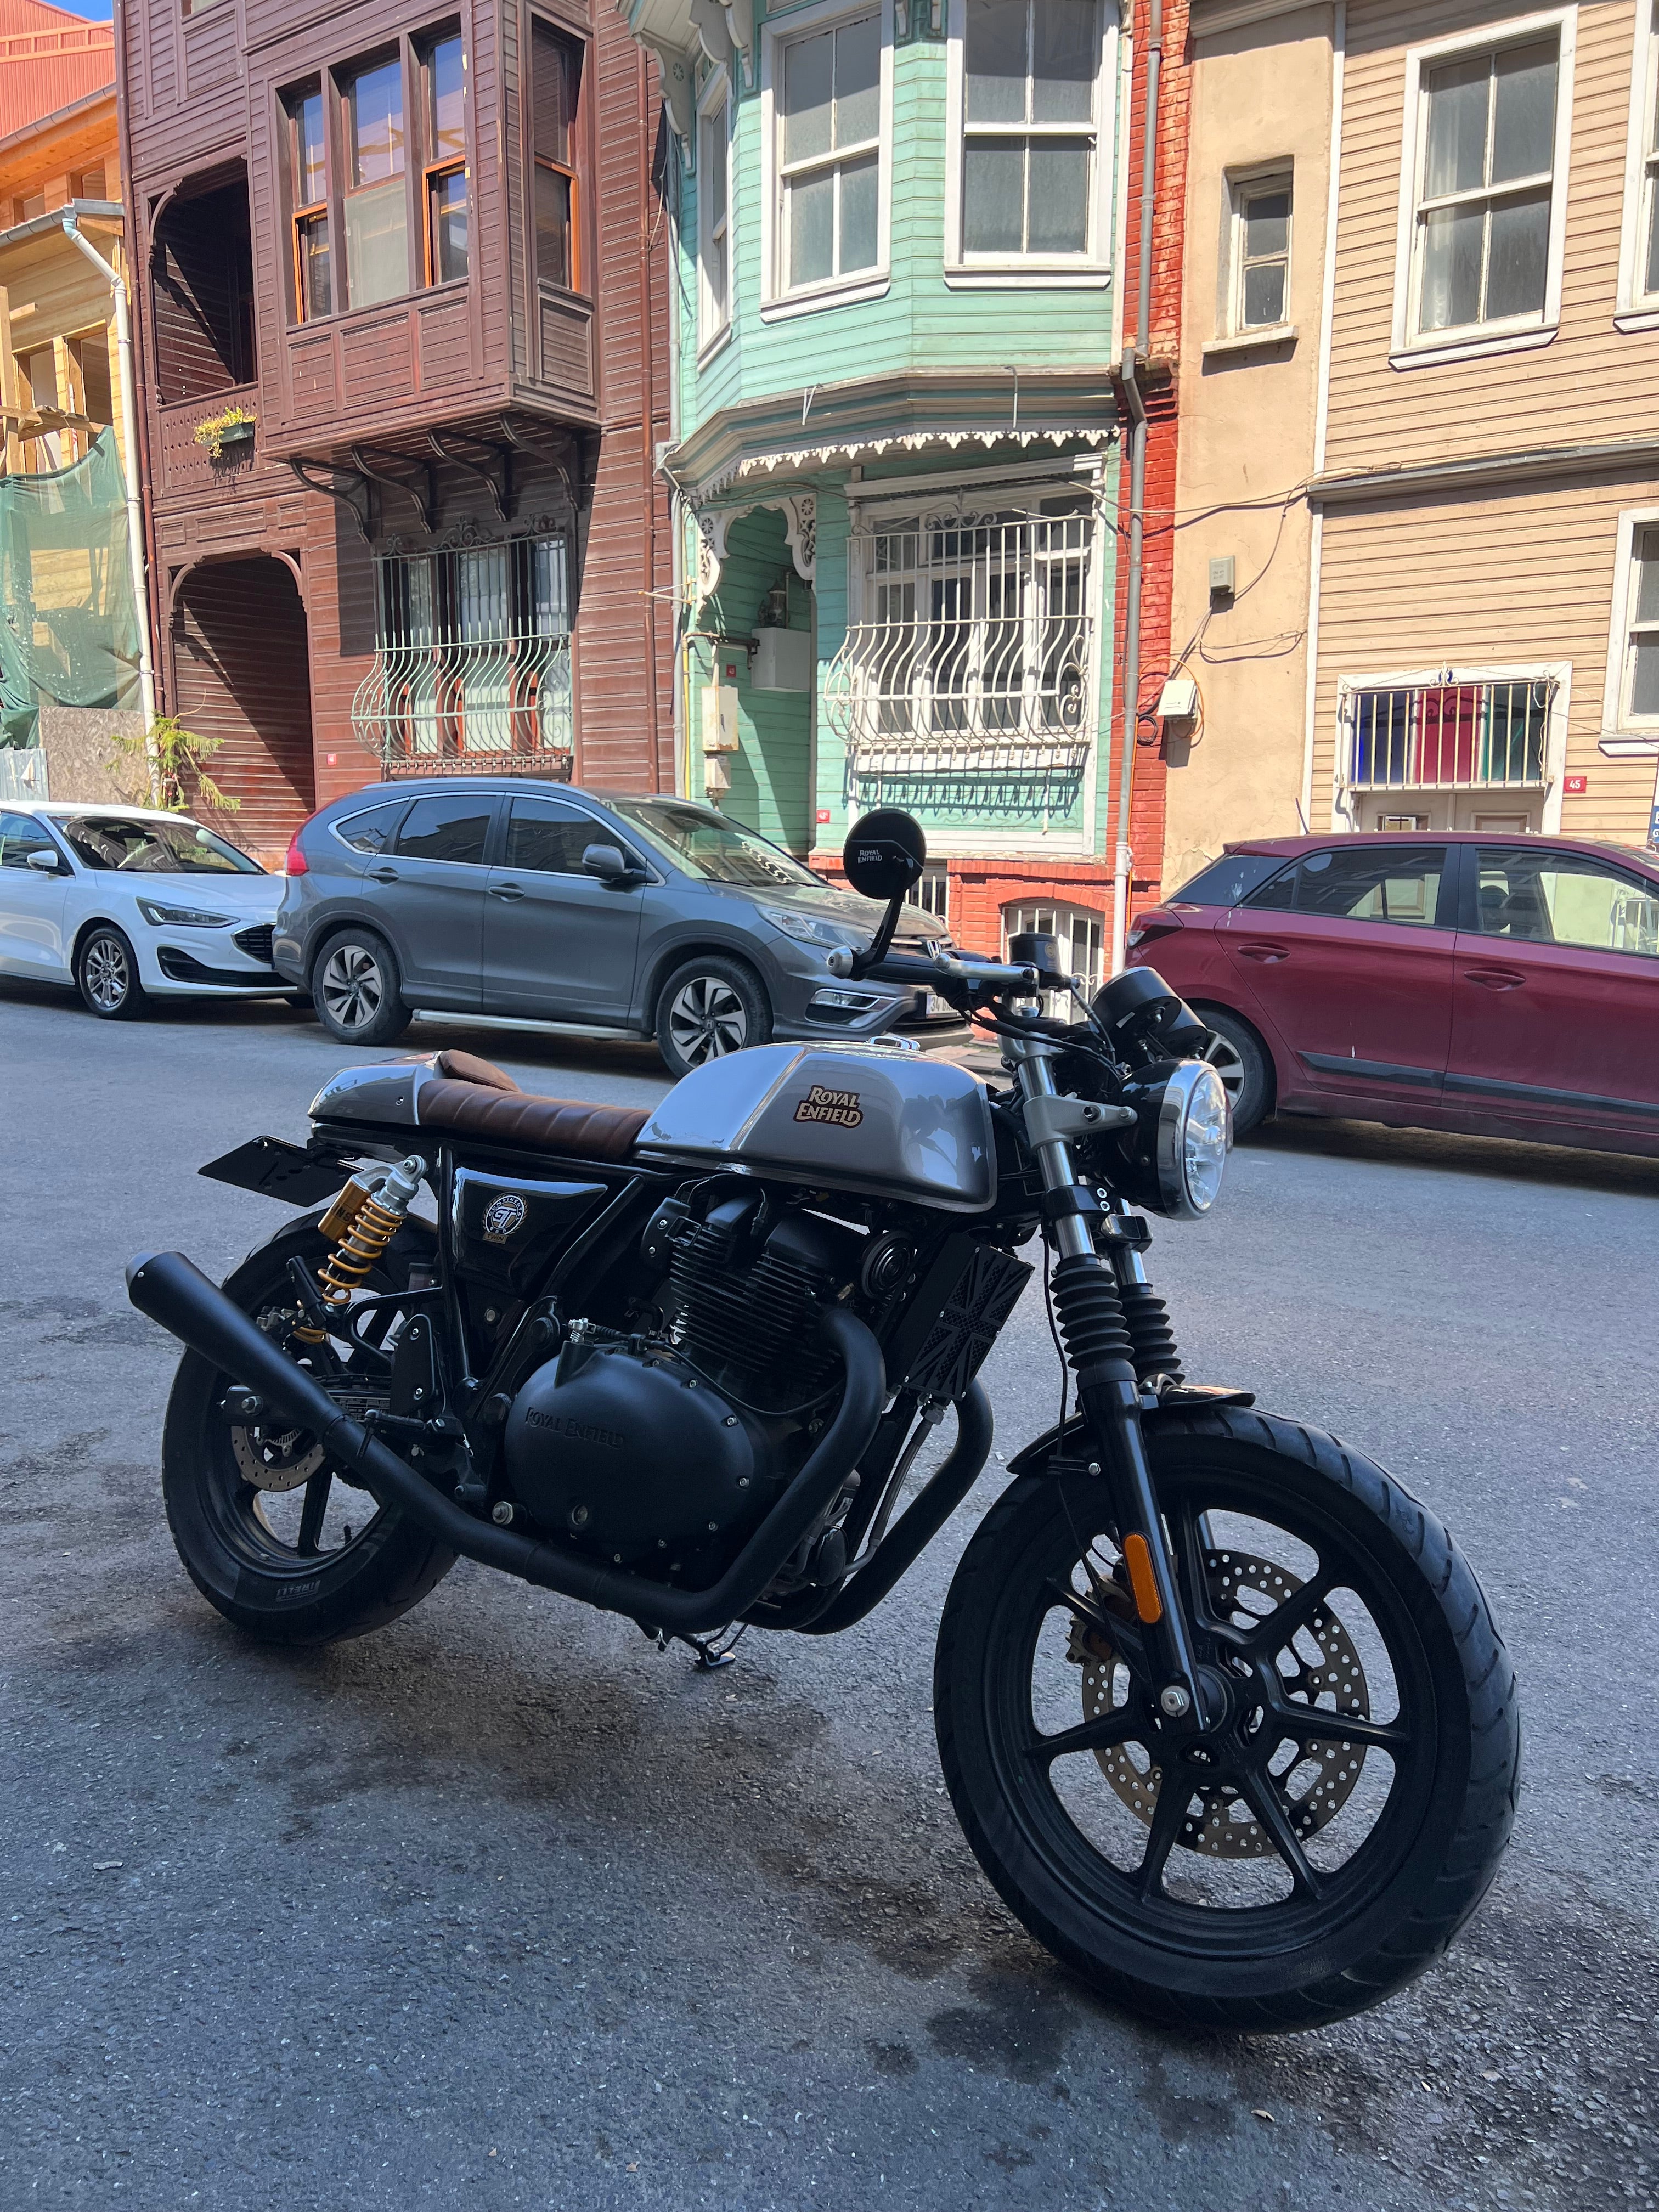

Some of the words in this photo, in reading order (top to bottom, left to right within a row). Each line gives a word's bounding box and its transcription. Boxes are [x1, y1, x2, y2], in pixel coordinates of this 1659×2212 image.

[1569, 780, 1581, 789] 45
[857, 855, 883, 864] ENFIELD
[930, 996, 940, 1012] 34
[809, 1087, 857, 1108] ROYAL
[795, 1102, 861, 1126] ENFIELD
[489, 1198, 522, 1221] CONTINENTAL
[493, 1206, 517, 1228] GT
[563, 1418, 624, 1450] ENFIELD
[275, 1579, 321, 1602] PIRELLI
